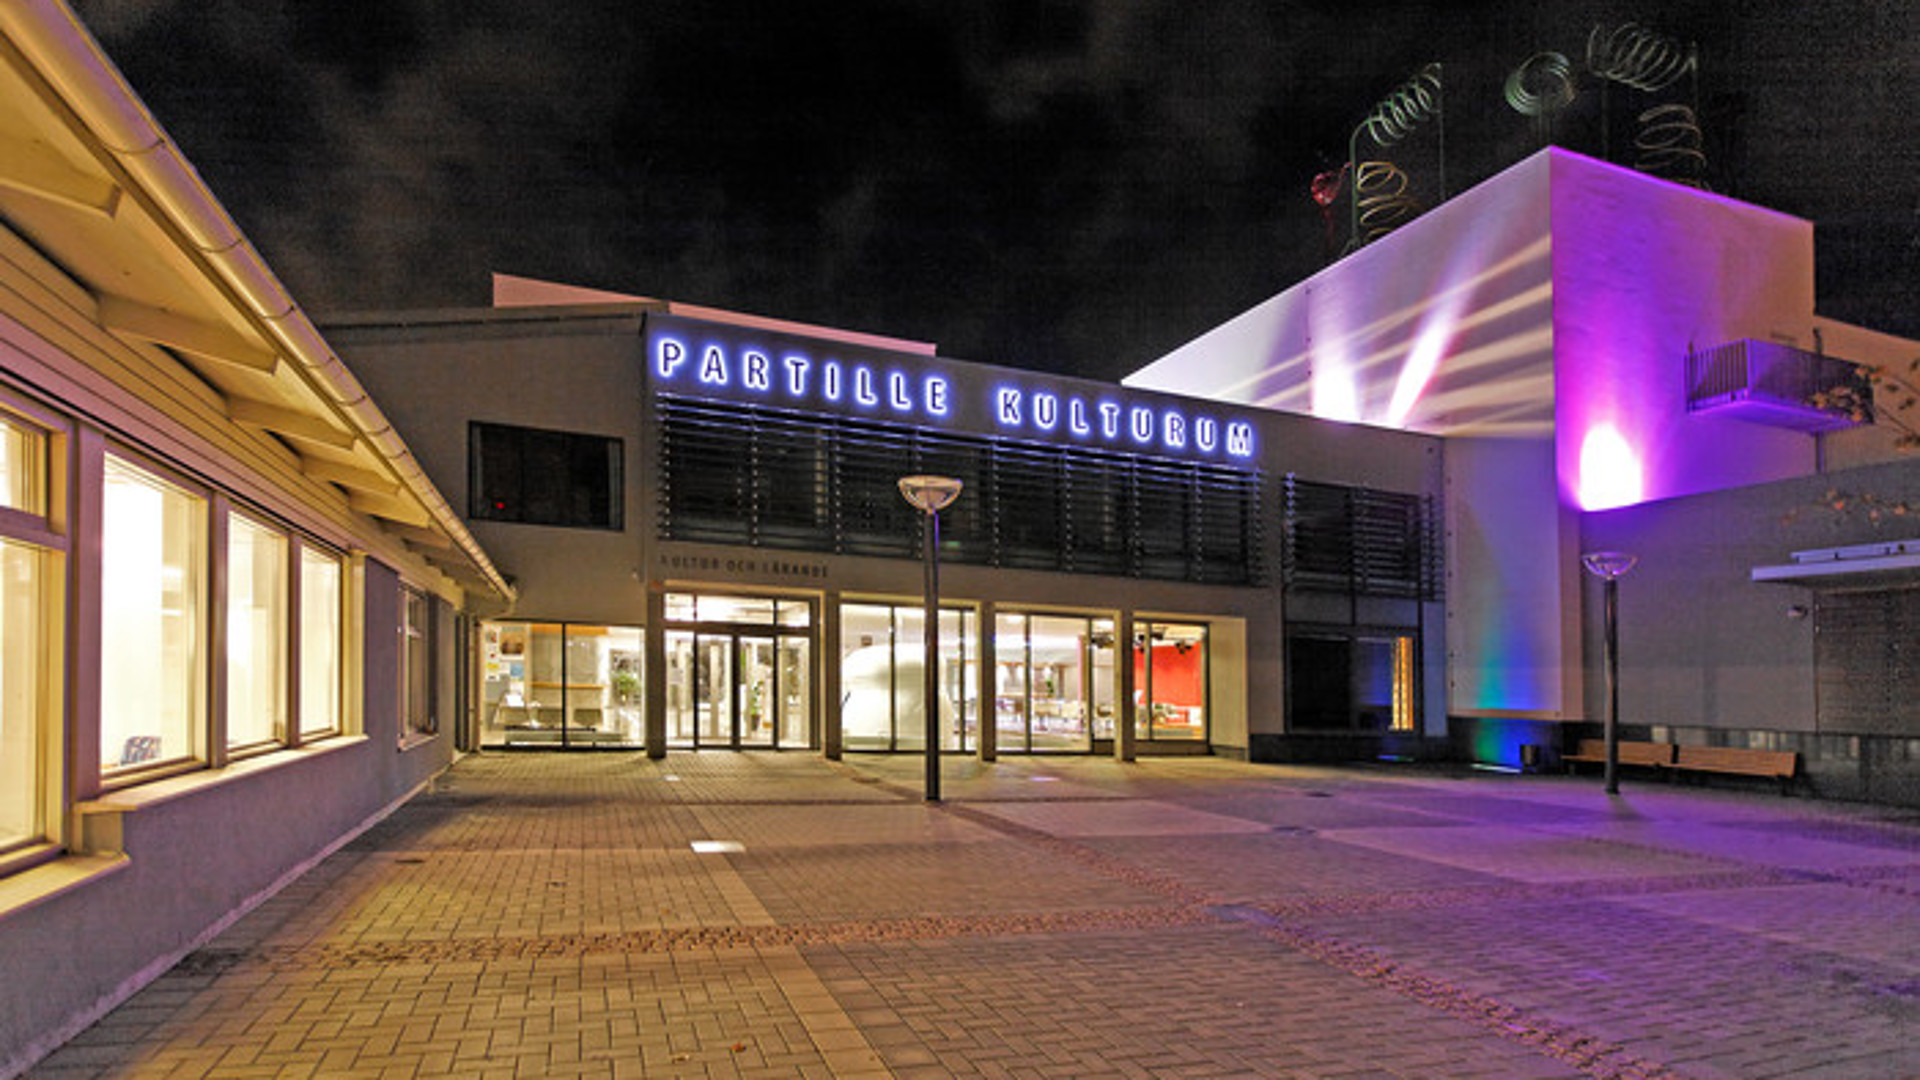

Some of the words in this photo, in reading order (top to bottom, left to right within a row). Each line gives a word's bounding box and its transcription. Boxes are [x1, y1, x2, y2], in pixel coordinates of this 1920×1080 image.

[658, 340, 948, 413] PARTILLE
[998, 388, 1254, 456] KULTURUM
[726, 559, 756, 573] OCH
